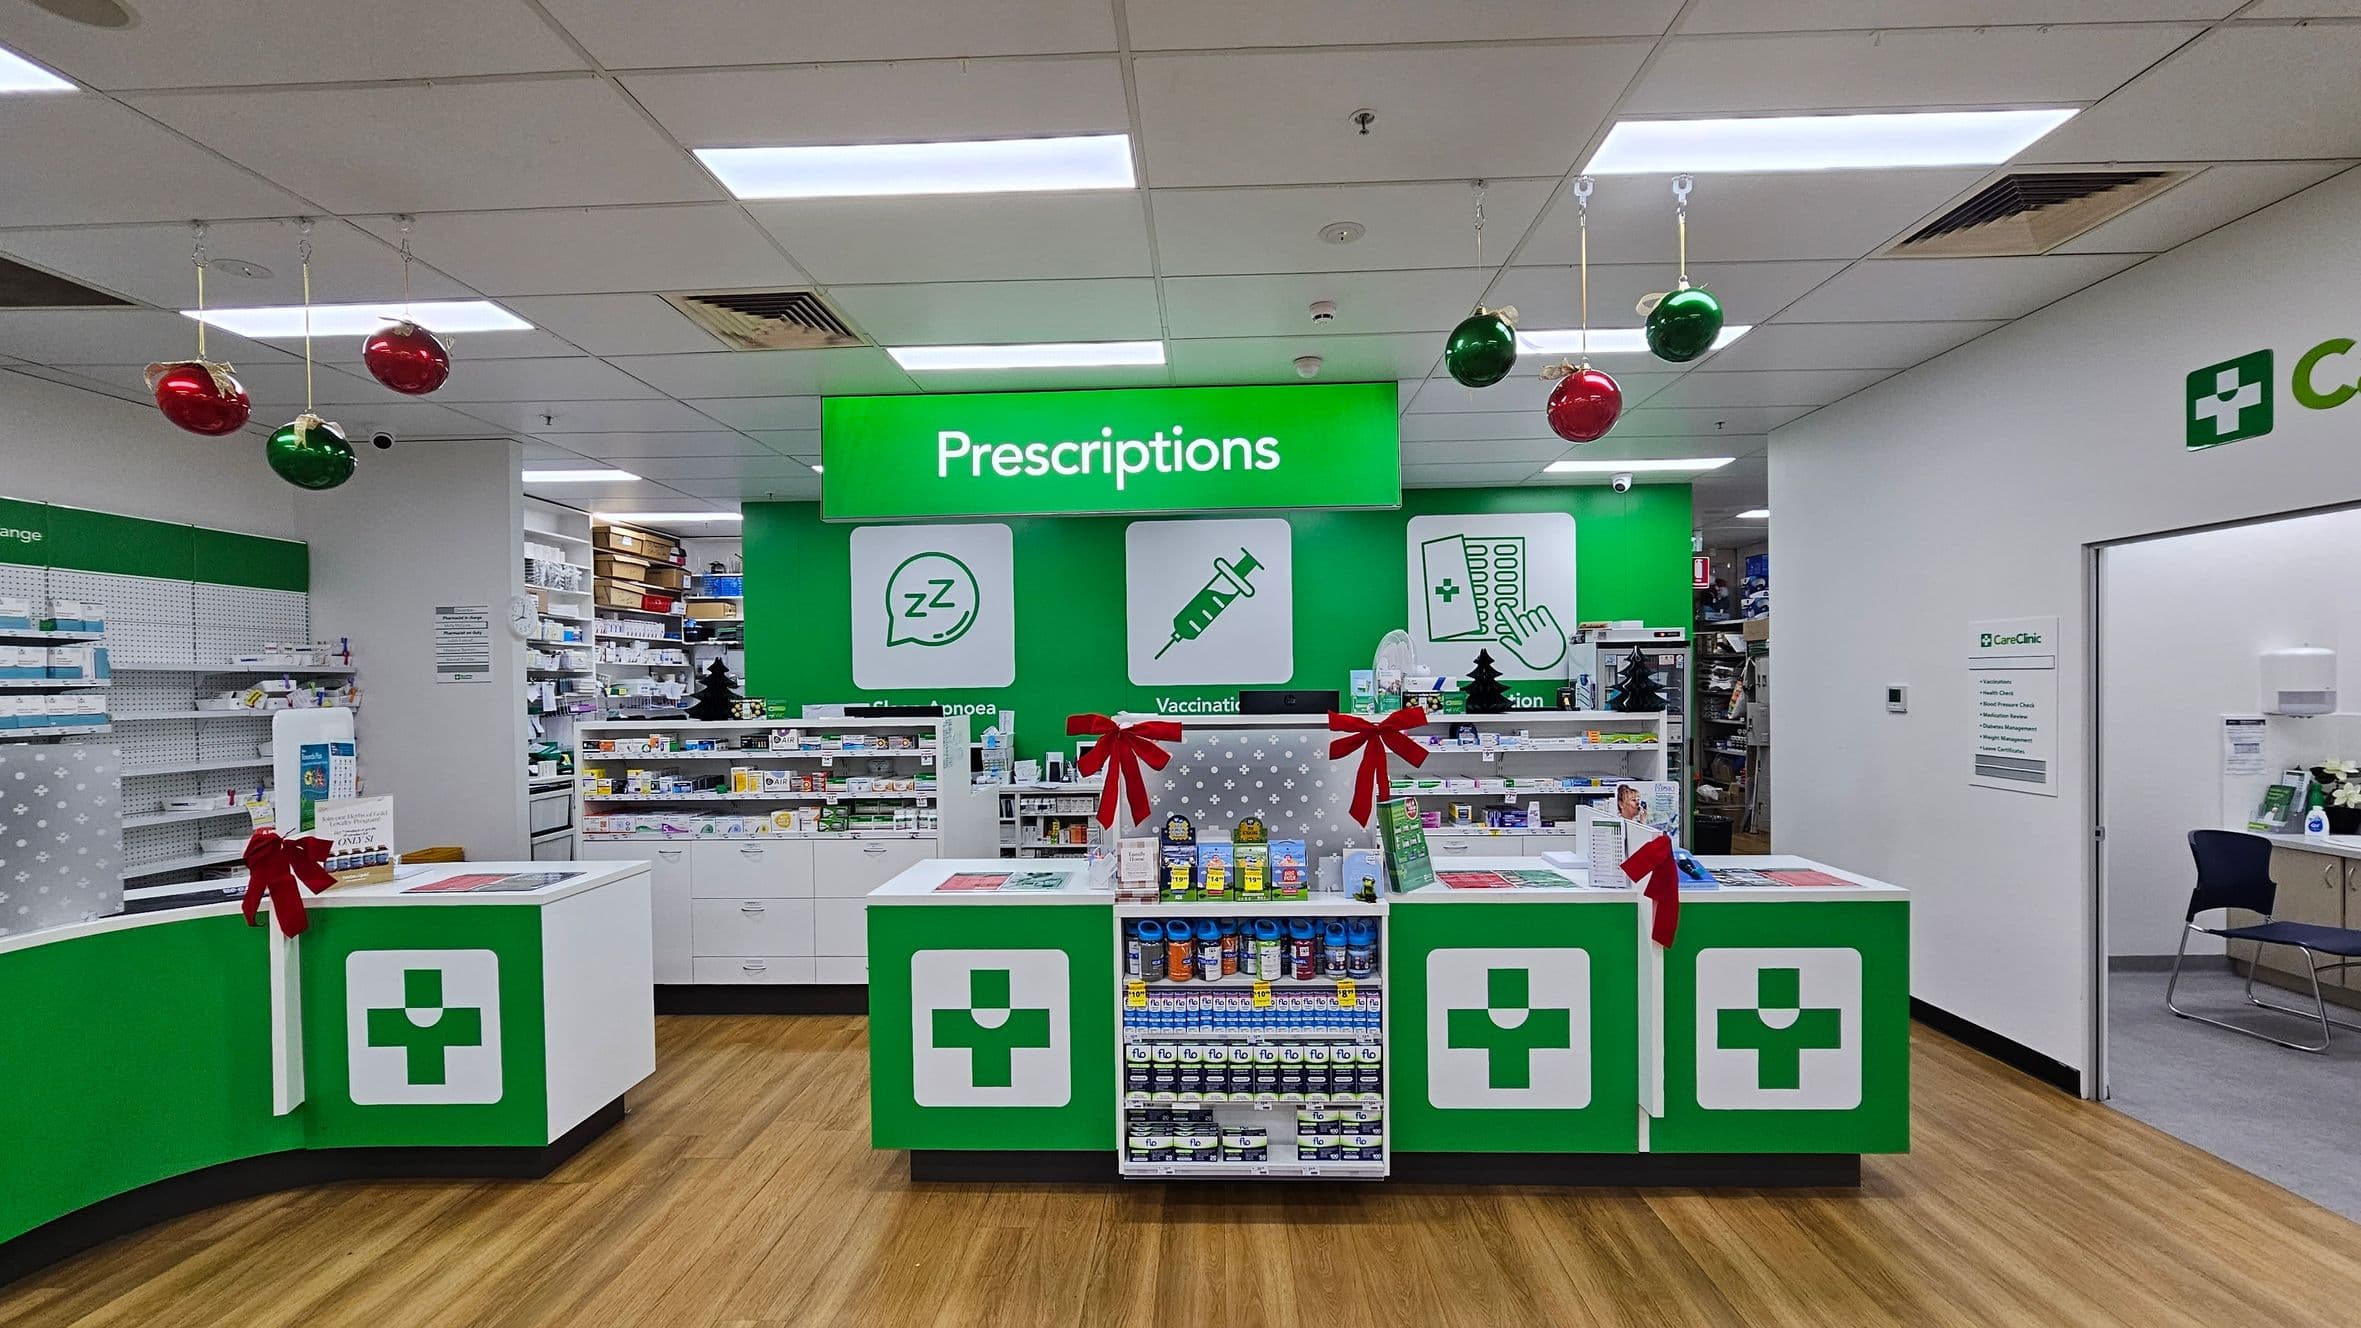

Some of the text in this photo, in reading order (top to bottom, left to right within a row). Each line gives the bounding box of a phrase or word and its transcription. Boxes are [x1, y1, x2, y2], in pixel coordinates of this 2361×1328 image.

[2292, 338, 2361, 409] C
[938, 425, 1281, 491] Prescriptions
[1994, 632, 2041, 645] CareClinic
[2004, 724, 2037, 732] Management
[2000, 735, 2032, 743] Management
[338, 836, 362, 846] ONLY
[1132, 1048, 1146, 1058] flo
[1158, 1049, 1172, 1059] flo
[1184, 1049, 1198, 1059] flo
[1209, 1049, 1223, 1059] flo
[1234, 1049, 1248, 1059] flo
[1260, 1049, 1273, 1059] flo
[1285, 1049, 1298, 1059] flo
[1310, 1049, 1324, 1059] flo
[1337, 1049, 1351, 1059] flo
[1362, 1049, 1376, 1059] flo
[1146, 1138, 1157, 1147] flo
[1190, 1138, 1201, 1147] flo
[1239, 1137, 1251, 1145] flo
[1313, 1137, 1324, 1145] flo
[1355, 1137, 1367, 1145] flo
